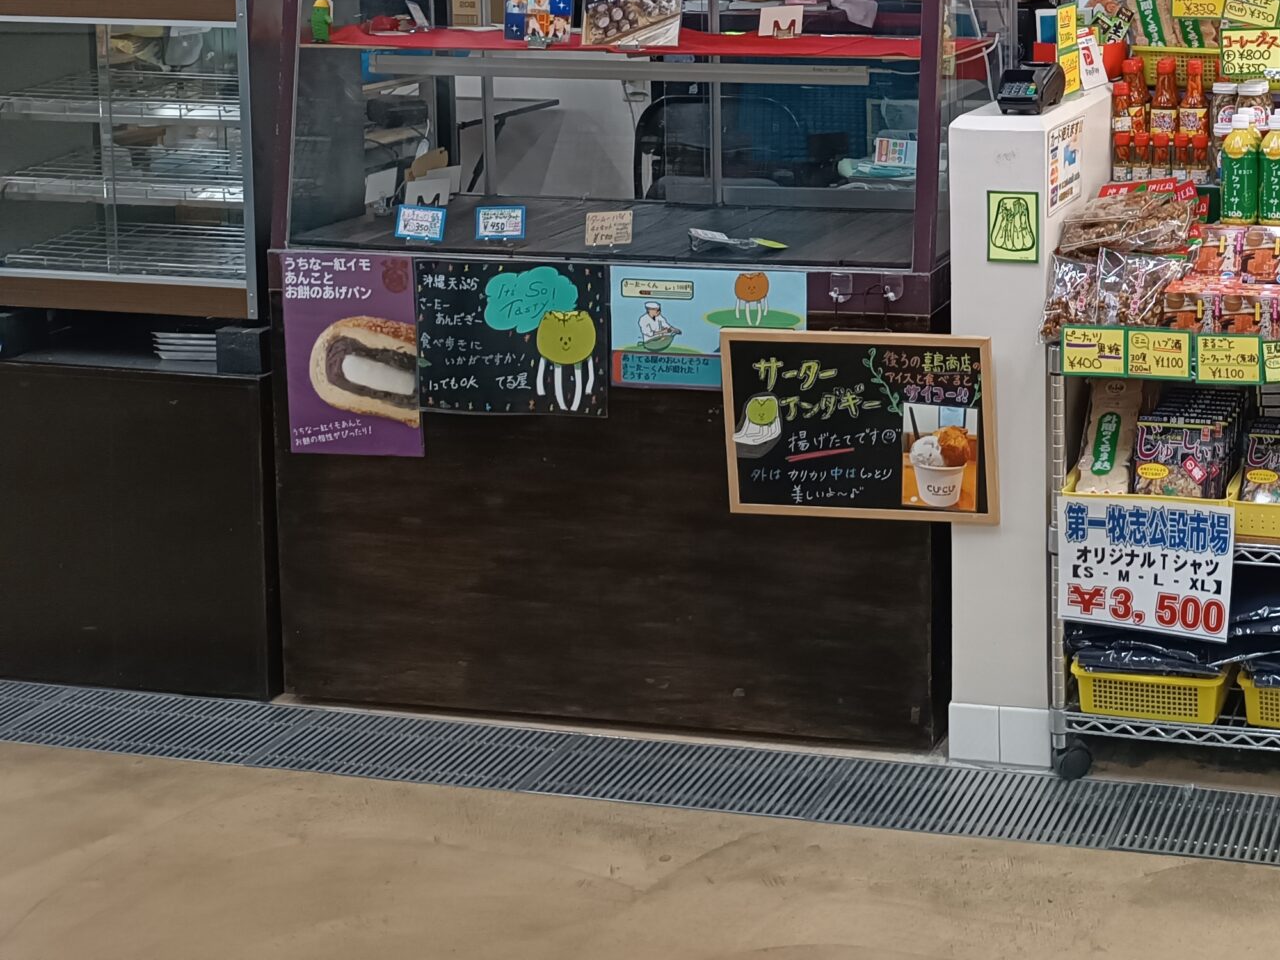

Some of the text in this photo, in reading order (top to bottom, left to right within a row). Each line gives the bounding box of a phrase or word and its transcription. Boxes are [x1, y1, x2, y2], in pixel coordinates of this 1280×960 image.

[1183, 2, 1217, 13] ¥350
[1249, 7, 1275, 23] ¥350
[1237, 50, 1272, 61] ¥800
[1237, 63, 1267, 74] ¥350
[482, 220, 505, 231] ¥450
[284, 257, 371, 272] うちなー紅イモ
[284, 271, 334, 285] あんこと
[422, 274, 480, 291] 沖縄天ぷら
[623, 280, 658, 290] さーたーくん
[285, 286, 372, 300] お餅のあげパン
[419, 298, 450, 310] さーたー
[435, 311, 484, 326] あんだぎー
[420, 331, 483, 351] 食べ歩きに
[1065, 330, 1102, 344] ピーナッツ
[1133, 336, 1182, 350] ミニ ハブ酒
[1098, 342, 1122, 356] 黒糖
[1202, 339, 1235, 350] まるごと
[445, 352, 525, 367] いかがですか!
[1067, 356, 1103, 370] ¥400
[752, 356, 839, 392] サーター
[1129, 365, 1151, 373] 200ml
[496, 372, 532, 390] てる屋
[884, 371, 972, 386] アイスと食べると
[779, 382, 883, 422] アンダギー
[292, 418, 362, 436] うちなー紅イモあんと
[1065, 501, 1232, 557] 第一牧志公設市場
[1076, 546, 1220, 577] オリジナルTシャツ
